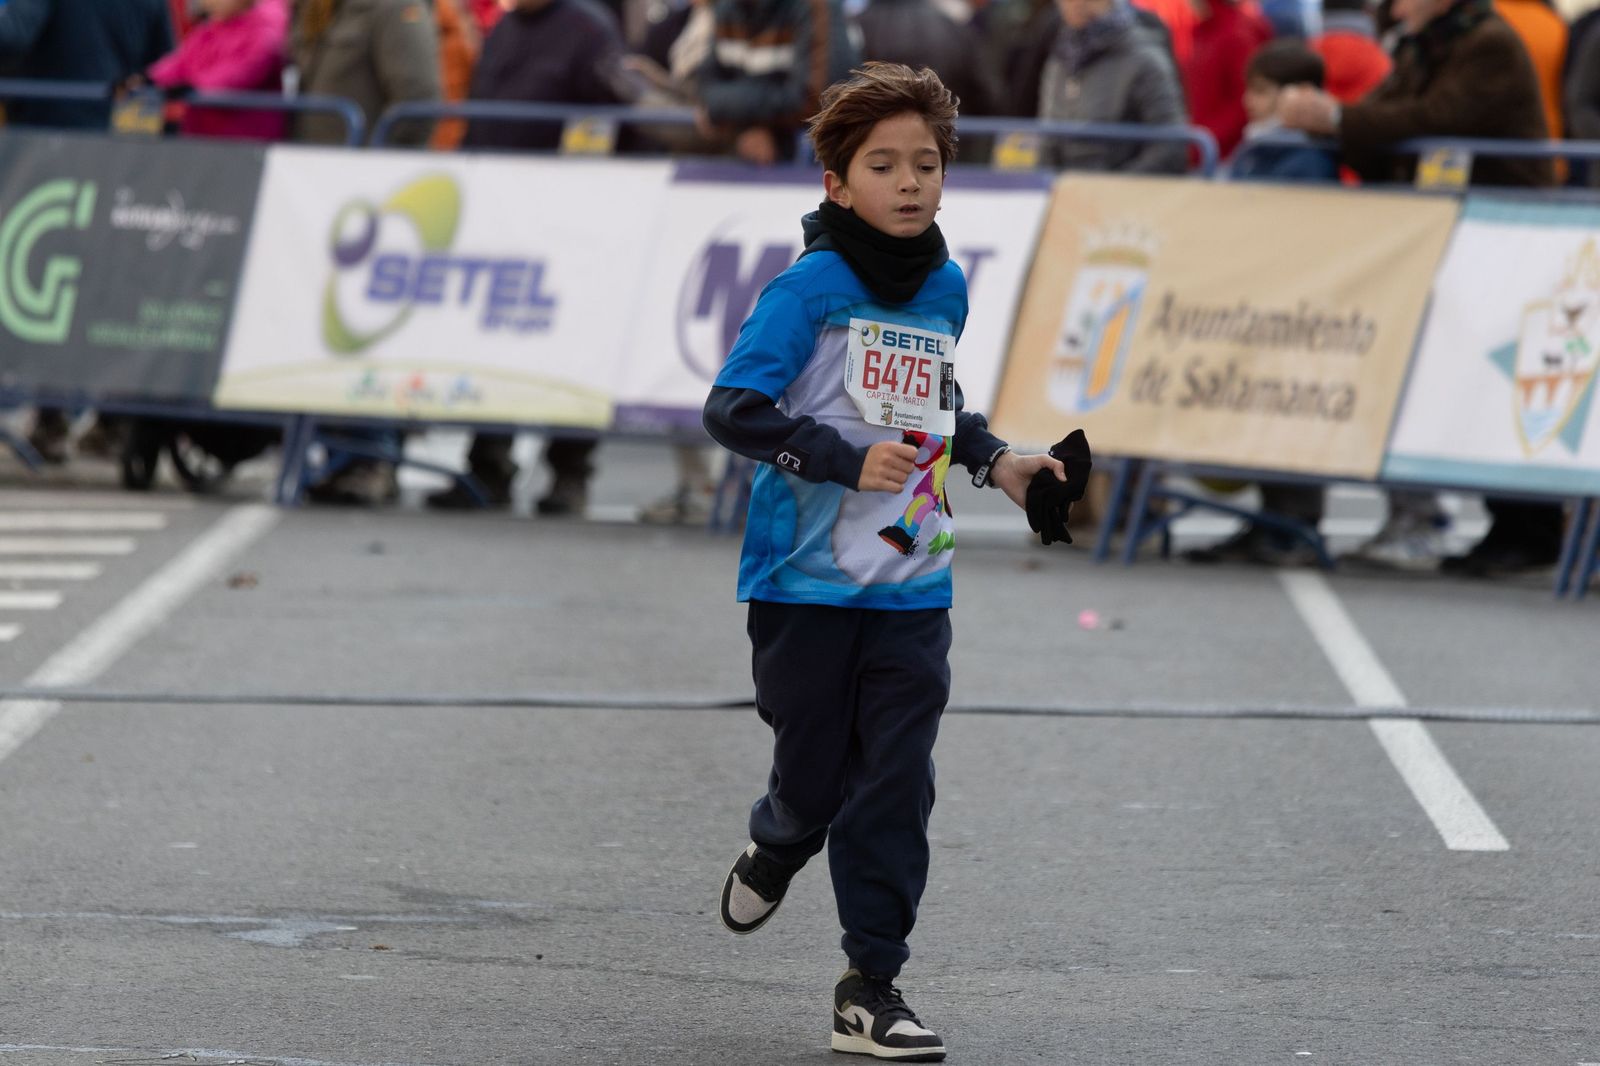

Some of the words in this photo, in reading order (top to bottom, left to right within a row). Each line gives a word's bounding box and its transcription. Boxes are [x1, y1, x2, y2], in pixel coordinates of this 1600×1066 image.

[367, 254, 556, 308] SETEL
[882, 330, 945, 356] SETEL
[1149, 291, 1376, 354] Ayuntamiento
[862, 350, 932, 398] 6475
[1131, 359, 1168, 405] de
[1176, 357, 1356, 422] Salamanca
[894, 411, 923, 421] Ayuntamiento
[902, 396, 926, 406] MARIO
